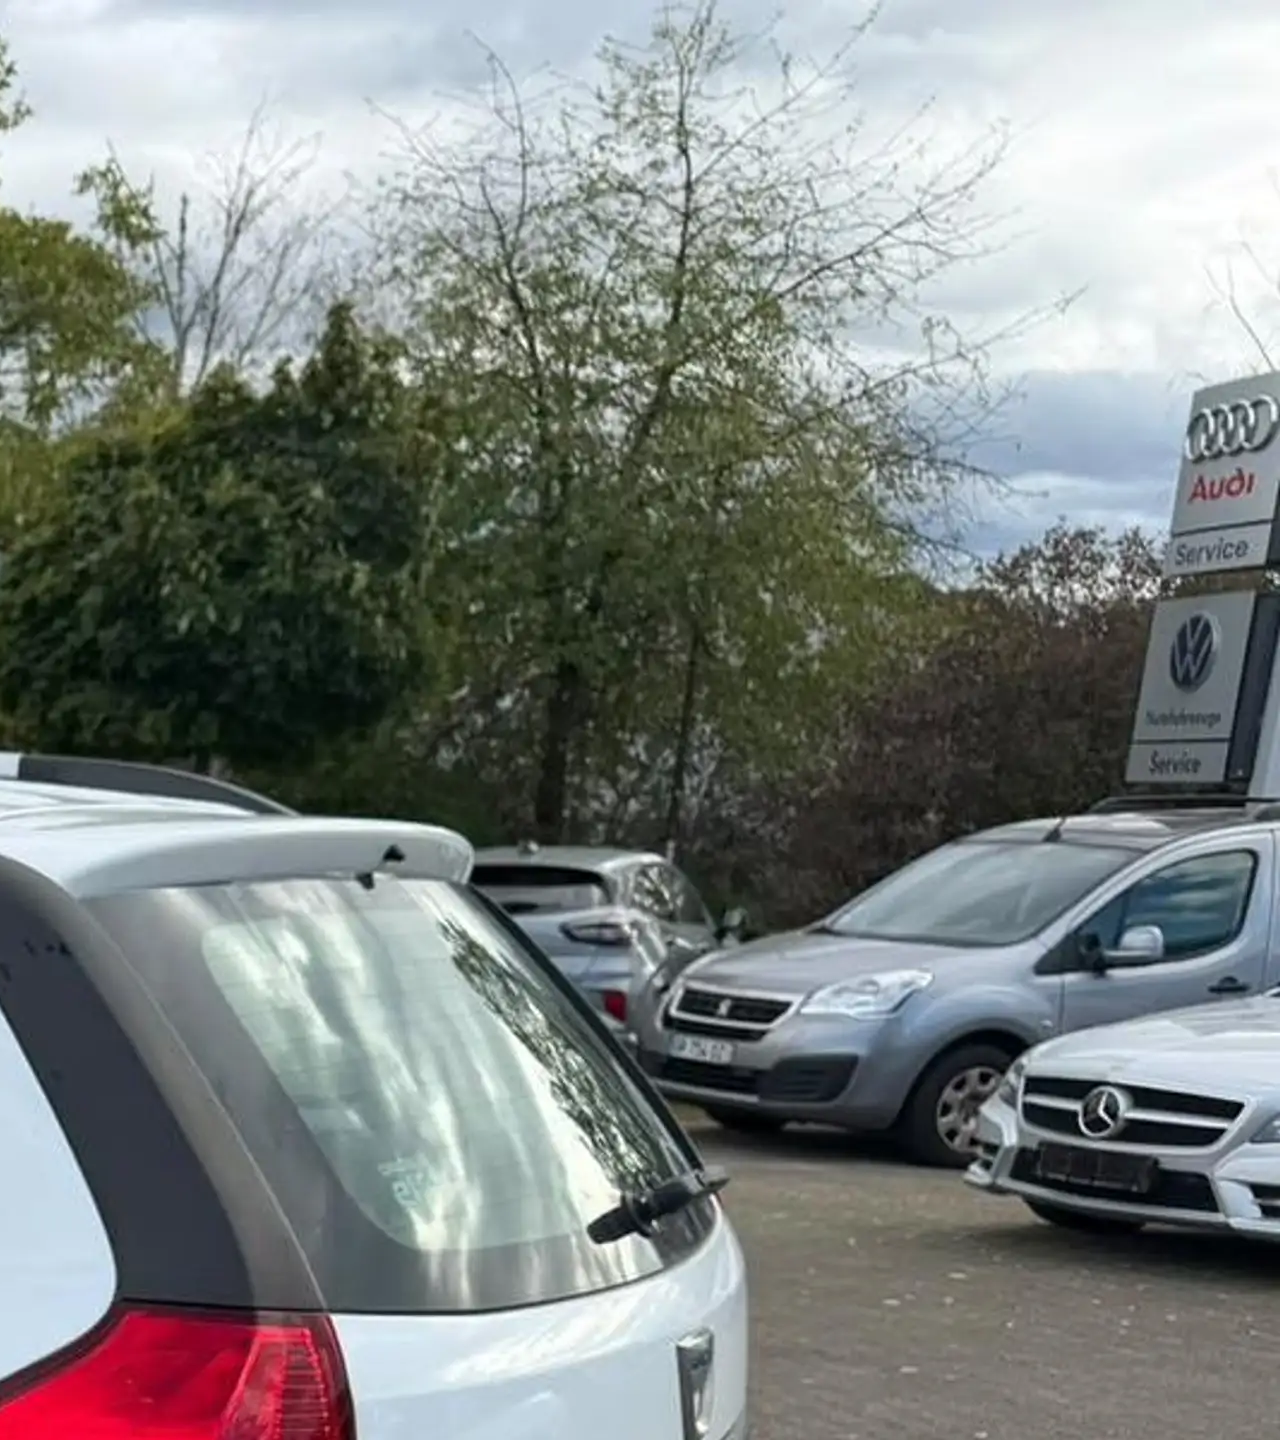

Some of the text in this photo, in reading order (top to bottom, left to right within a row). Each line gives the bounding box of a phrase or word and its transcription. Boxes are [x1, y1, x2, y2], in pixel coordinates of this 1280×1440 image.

[1188, 468, 1255, 503] Audi
[1175, 538, 1249, 566] Service
[1149, 750, 1202, 776] Service
